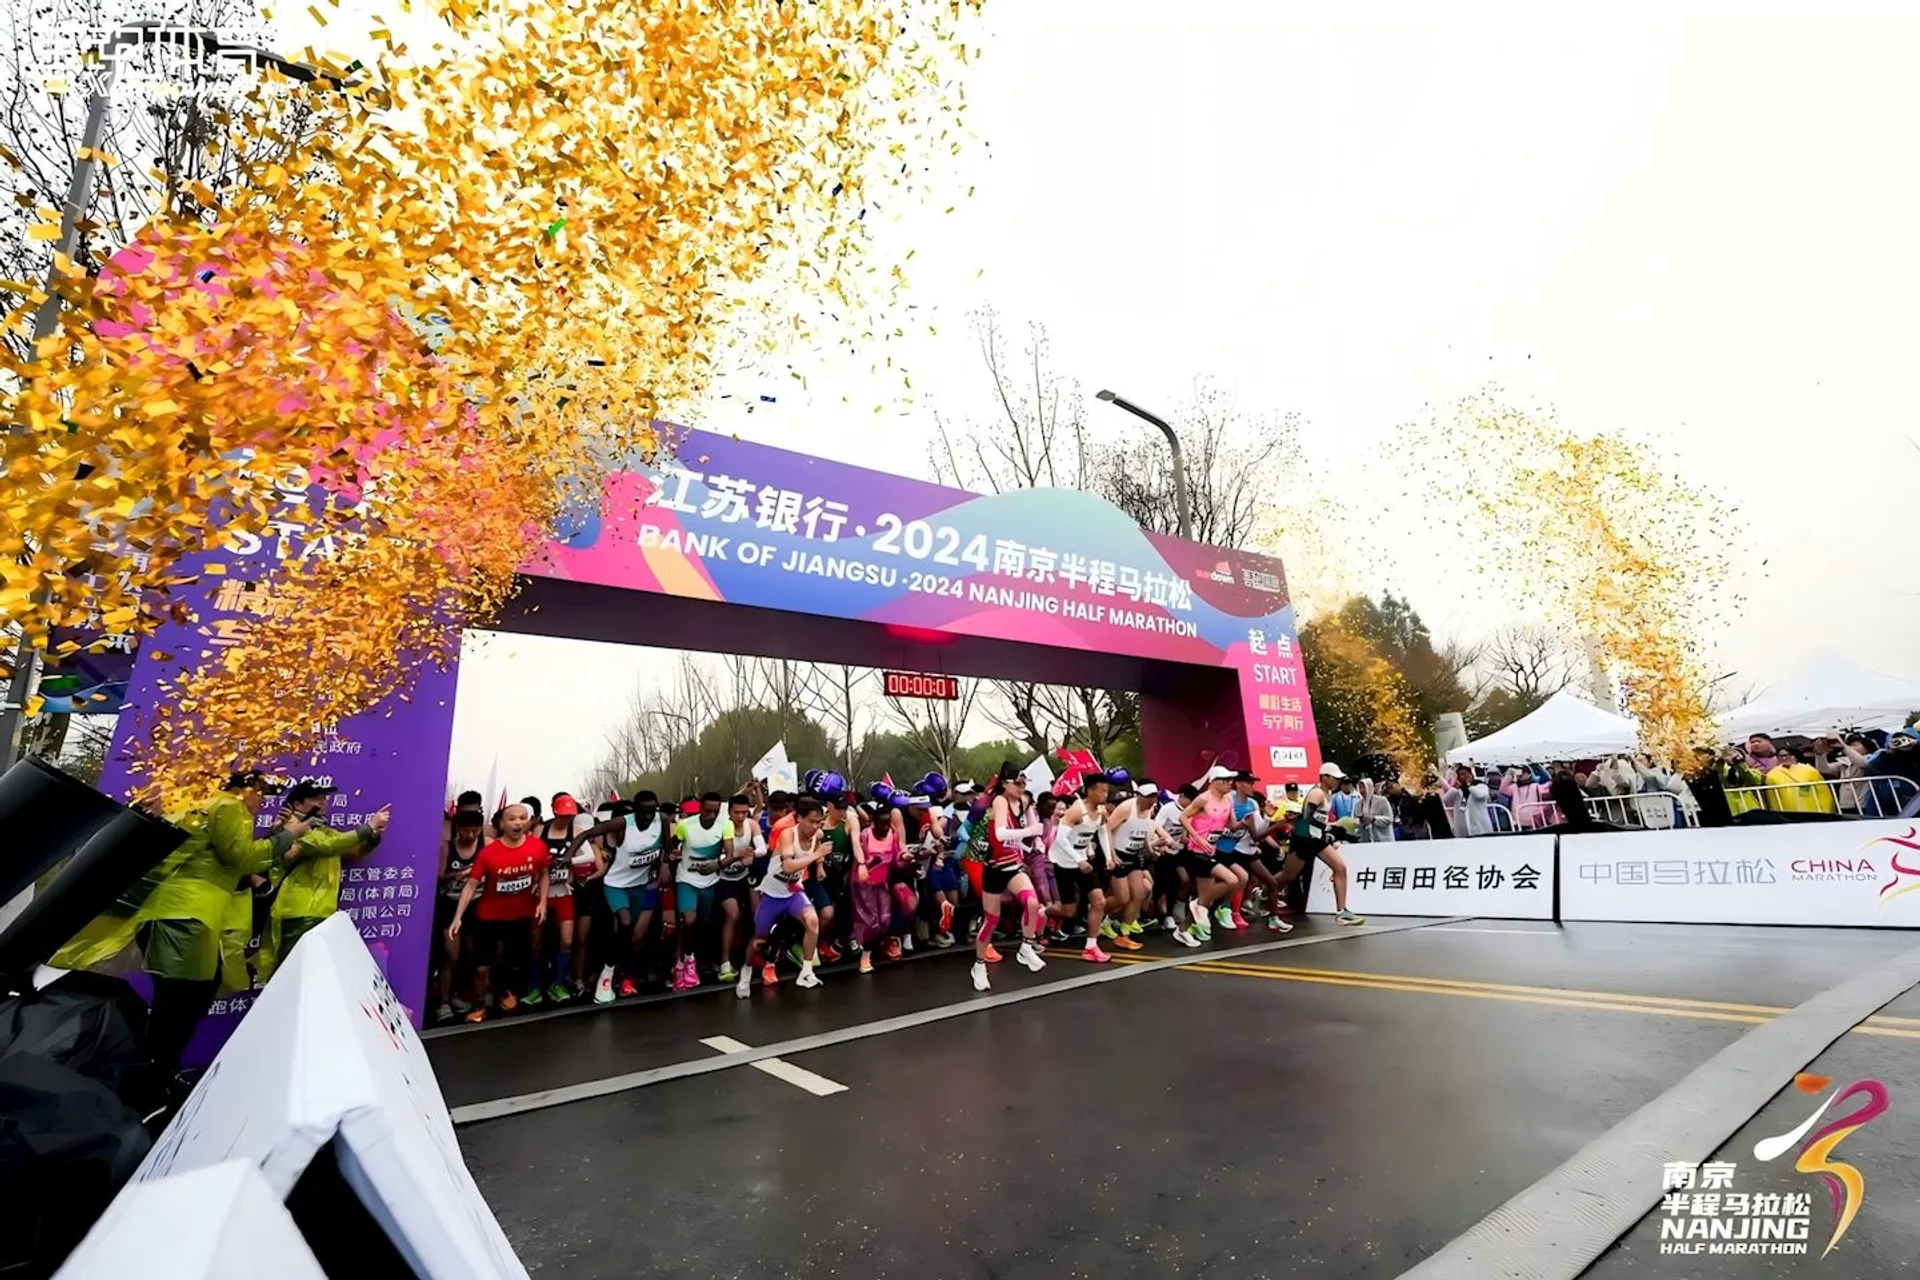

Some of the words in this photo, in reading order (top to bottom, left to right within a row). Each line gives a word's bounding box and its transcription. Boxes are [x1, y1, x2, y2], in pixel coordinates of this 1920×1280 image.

[637, 524, 729, 560] BANK
[736, 541, 777, 566] OF
[969, 575, 1058, 615] NANJING
[1062, 603, 1105, 623] HALF
[1110, 608, 1197, 638] MARATHON
[888, 675, 955, 697] 00:00:01
[1254, 664, 1297, 686] START
[1578, 857, 1777, 886] 中国马拉松
[1791, 858, 1875, 873] CHINA
[1356, 862, 1542, 892] 中国田径协会
[1791, 873, 1877, 882] MARATHON
[357, 923, 402, 938] 公司)
